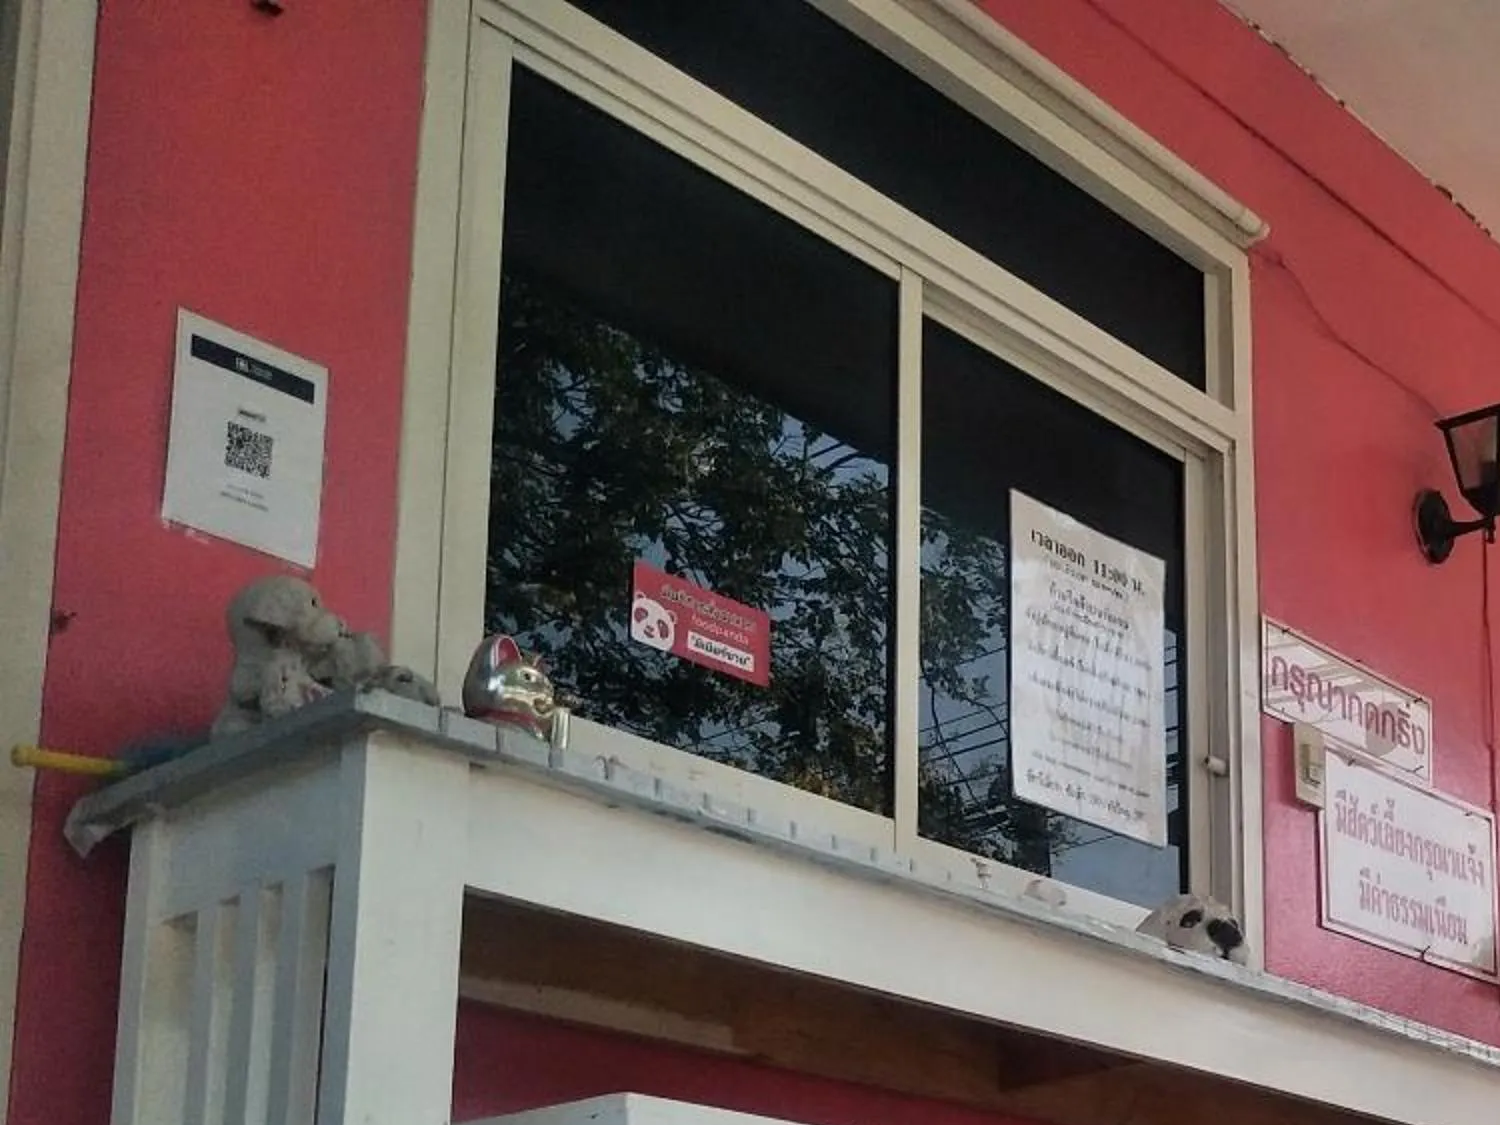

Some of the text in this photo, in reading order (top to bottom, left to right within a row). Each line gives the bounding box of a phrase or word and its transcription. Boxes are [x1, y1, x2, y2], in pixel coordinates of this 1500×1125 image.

[1031, 529, 1085, 567] เวลาออก
[1272, 655, 1425, 754] กรุณากดกริ่ง
[1359, 867, 1468, 945] มีค่าธรรมเนียม
